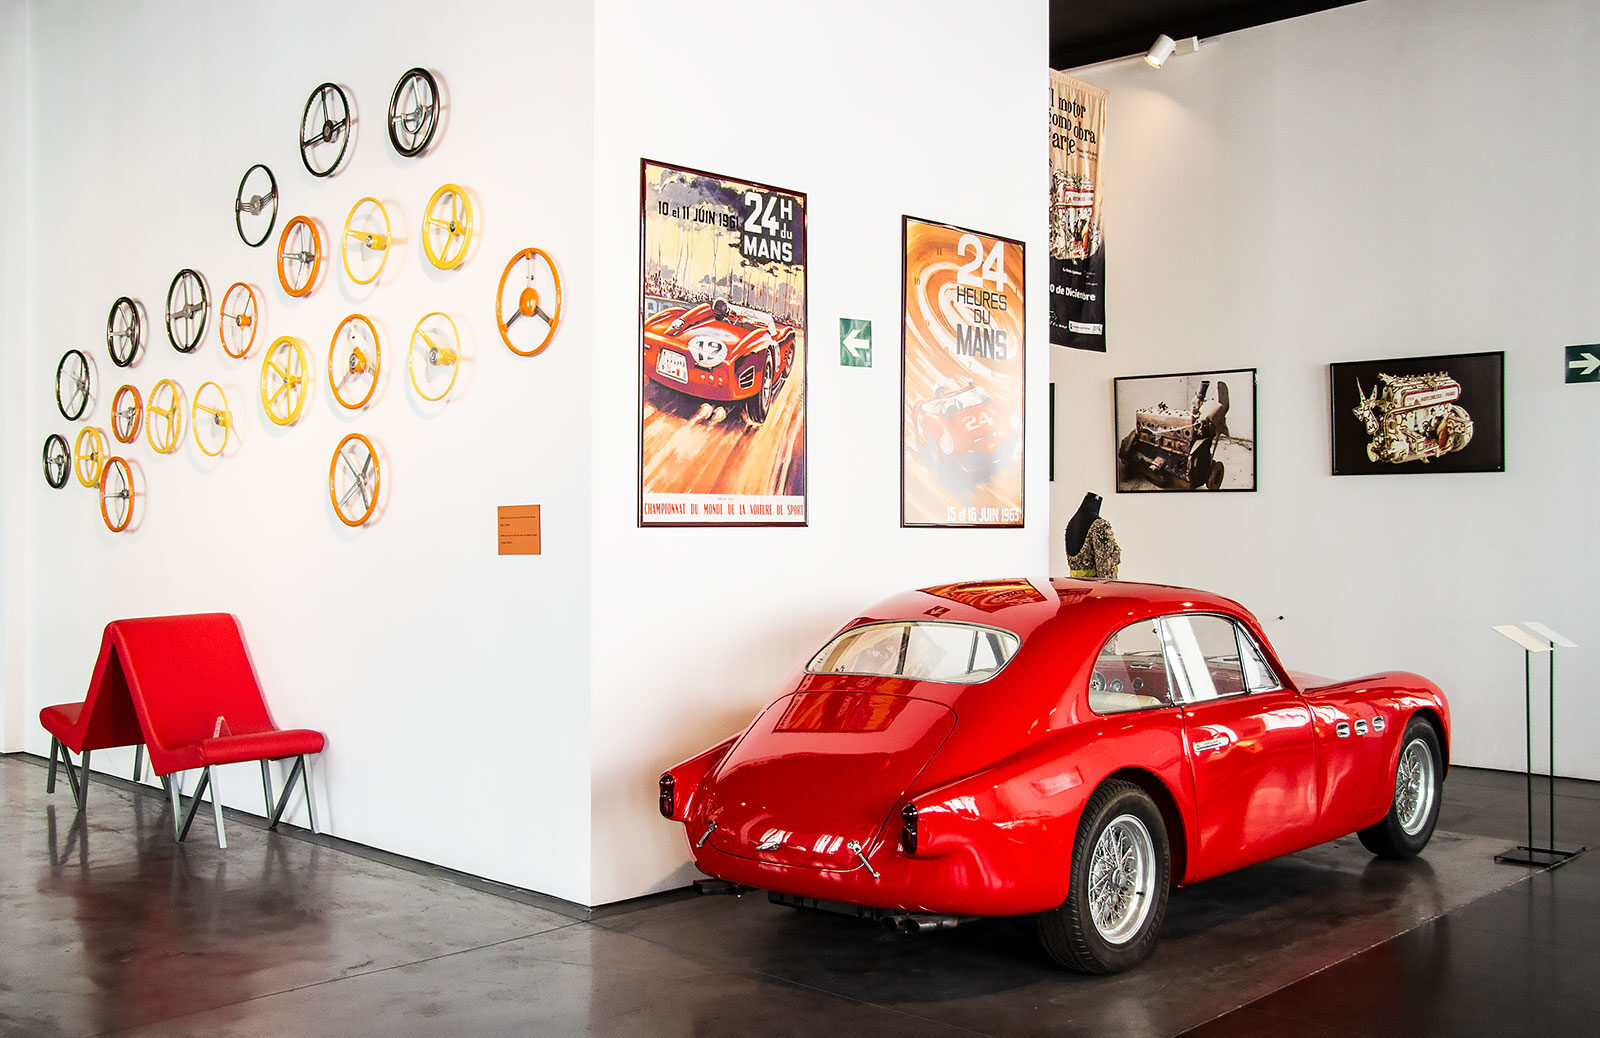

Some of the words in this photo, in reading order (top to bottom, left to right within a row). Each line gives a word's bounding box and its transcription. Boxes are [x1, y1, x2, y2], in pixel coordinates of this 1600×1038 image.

[1058, 96, 1086, 119] motor
[1052, 132, 1076, 156] arte
[1073, 121, 1096, 144] obra
[658, 200, 669, 216] 10
[682, 206, 690, 220] 11
[693, 208, 715, 226] JUIN
[719, 213, 739, 230] 1961
[744, 192, 780, 237] 24
[780, 198, 792, 221] H
[780, 224, 792, 240] du
[744, 234, 792, 262] MANS
[957, 233, 1008, 292] 24
[956, 286, 1007, 311] HEURES
[1056, 285, 1065, 295] de
[1066, 287, 1096, 301] Diciembre
[974, 308, 991, 325] DU
[956, 323, 1007, 361] MANS
[961, 411, 994, 432] 24
[644, 503, 685, 515] CHAMPIONNAT
[690, 504, 699, 515] DU
[704, 504, 723, 515] MONDE
[728, 504, 734, 515] DE
[739, 504, 746, 515] LA
[750, 504, 772, 516] VOITURE
[776, 504, 783, 516] DE
[787, 504, 804, 516] SPORT
[947, 506, 956, 521] 15
[968, 506, 977, 521] 16
[978, 507, 999, 522] JUIN
[1002, 507, 1020, 522] 1963
